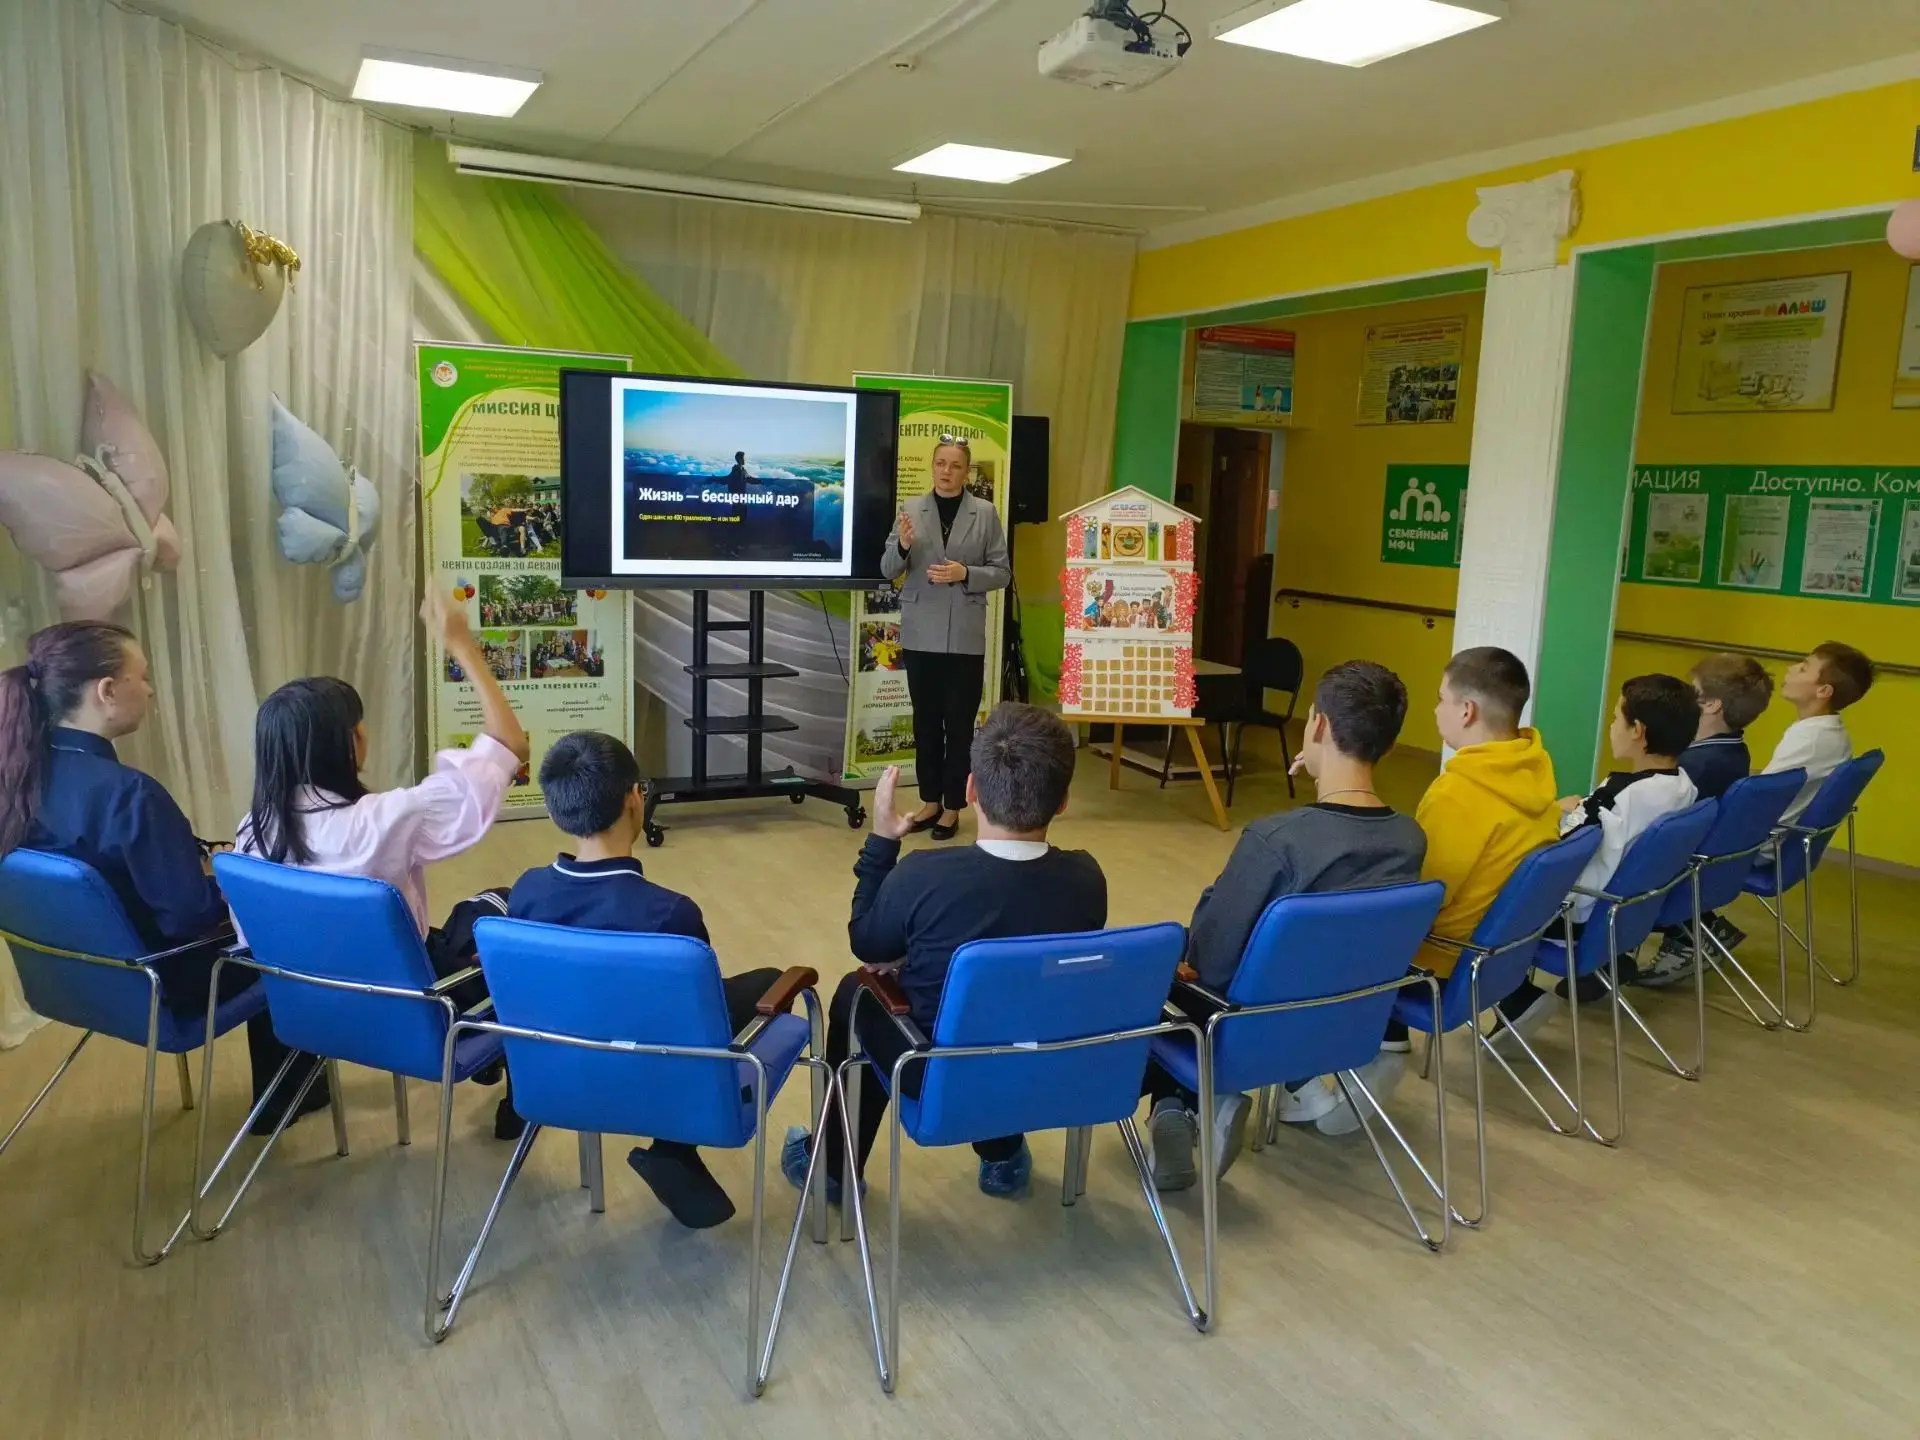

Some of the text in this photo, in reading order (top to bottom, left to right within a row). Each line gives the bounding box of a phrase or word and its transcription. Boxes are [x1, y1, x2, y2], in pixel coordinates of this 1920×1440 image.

[1764, 298, 1827, 317] МАЛЫШ
[472, 401, 541, 417] МИССИЯ
[899, 423, 985, 440] ЕНТРЕ РАБОТАЮТ
[1749, 470, 1867, 496] Доступно.
[638, 487, 684, 502] Жизнь
[701, 488, 774, 505] бесценный
[775, 493, 800, 508] дар
[1388, 527, 1449, 541] СЕМЕЙНЫЙ
[1387, 540, 1415, 552] МФЦ
